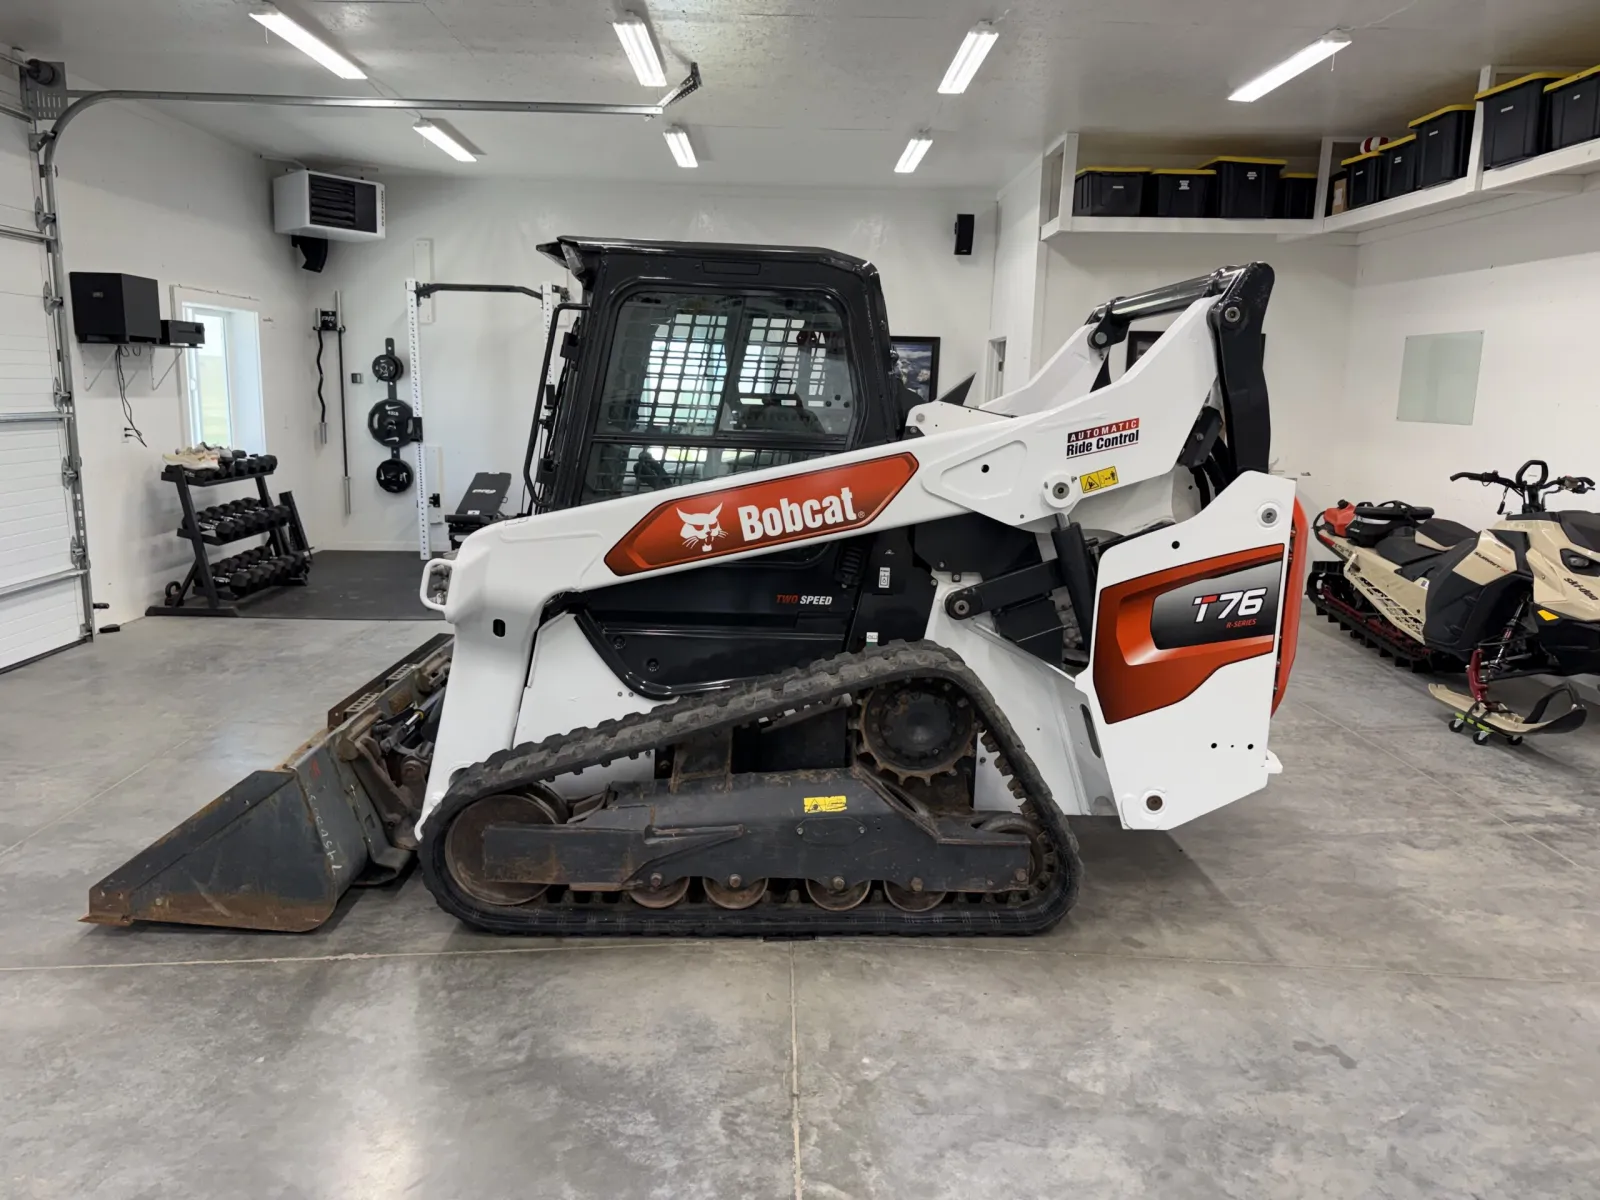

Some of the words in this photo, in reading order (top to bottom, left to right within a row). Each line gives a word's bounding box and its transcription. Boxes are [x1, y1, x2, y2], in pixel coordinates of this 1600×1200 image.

[1069, 419, 1138, 442] AUTOMATIC
[1066, 441, 1093, 456] Ride
[1096, 430, 1139, 450] Control
[738, 487, 857, 542] Bobcat
[776, 594, 799, 604] TWO
[799, 595, 833, 605] SPEED
[1563, 577, 1599, 600] ski-doo
[1192, 587, 1268, 623] T76
[1226, 618, 1257, 628] R-SERIES
